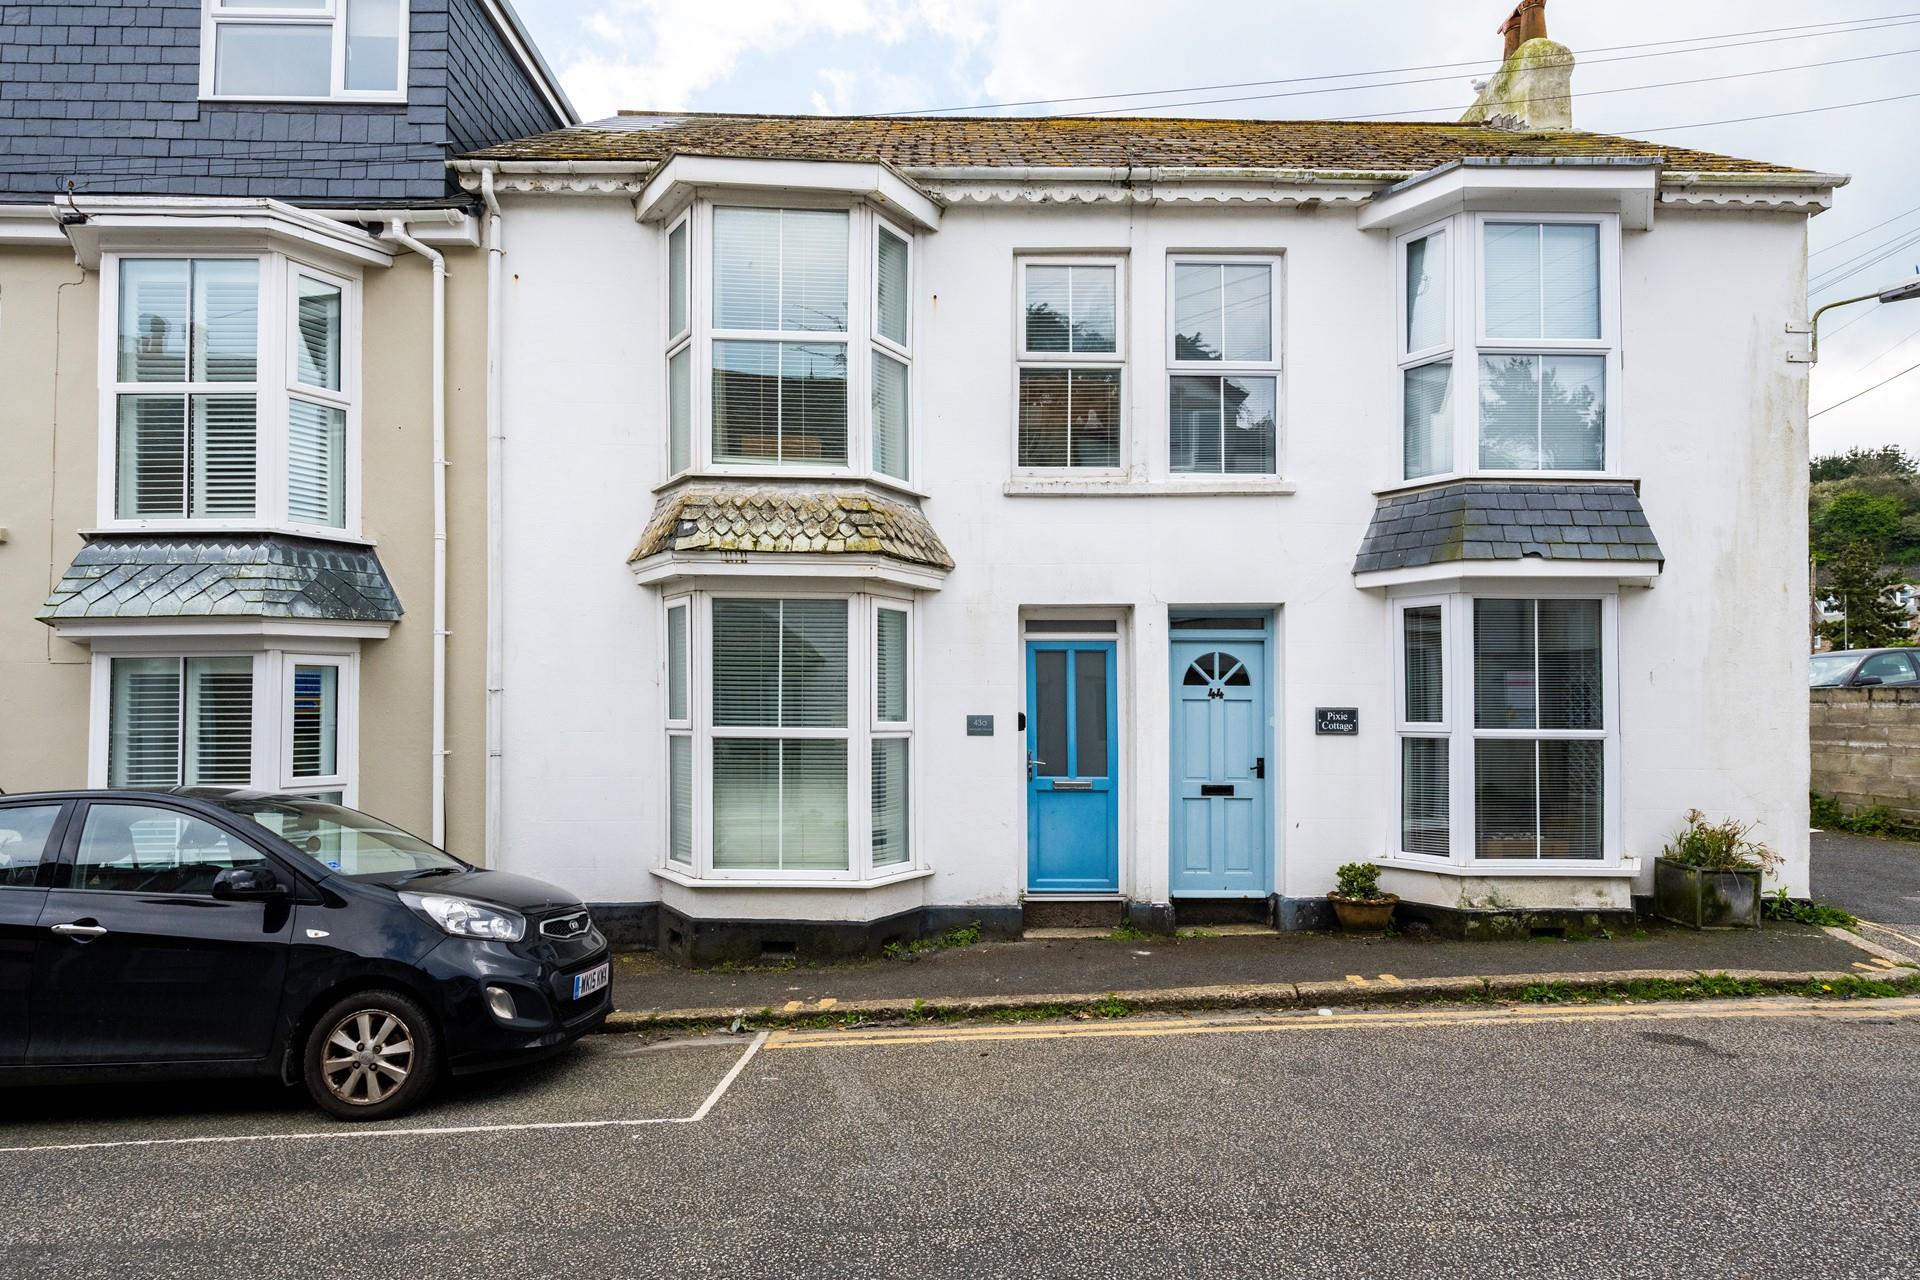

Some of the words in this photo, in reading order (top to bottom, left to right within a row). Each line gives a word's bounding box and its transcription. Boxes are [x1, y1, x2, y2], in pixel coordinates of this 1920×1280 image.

[1208, 688, 1224, 699] 44
[1327, 711, 1348, 720] Pixie
[973, 719, 988, 727] 43a
[1321, 721, 1353, 731] Cottage
